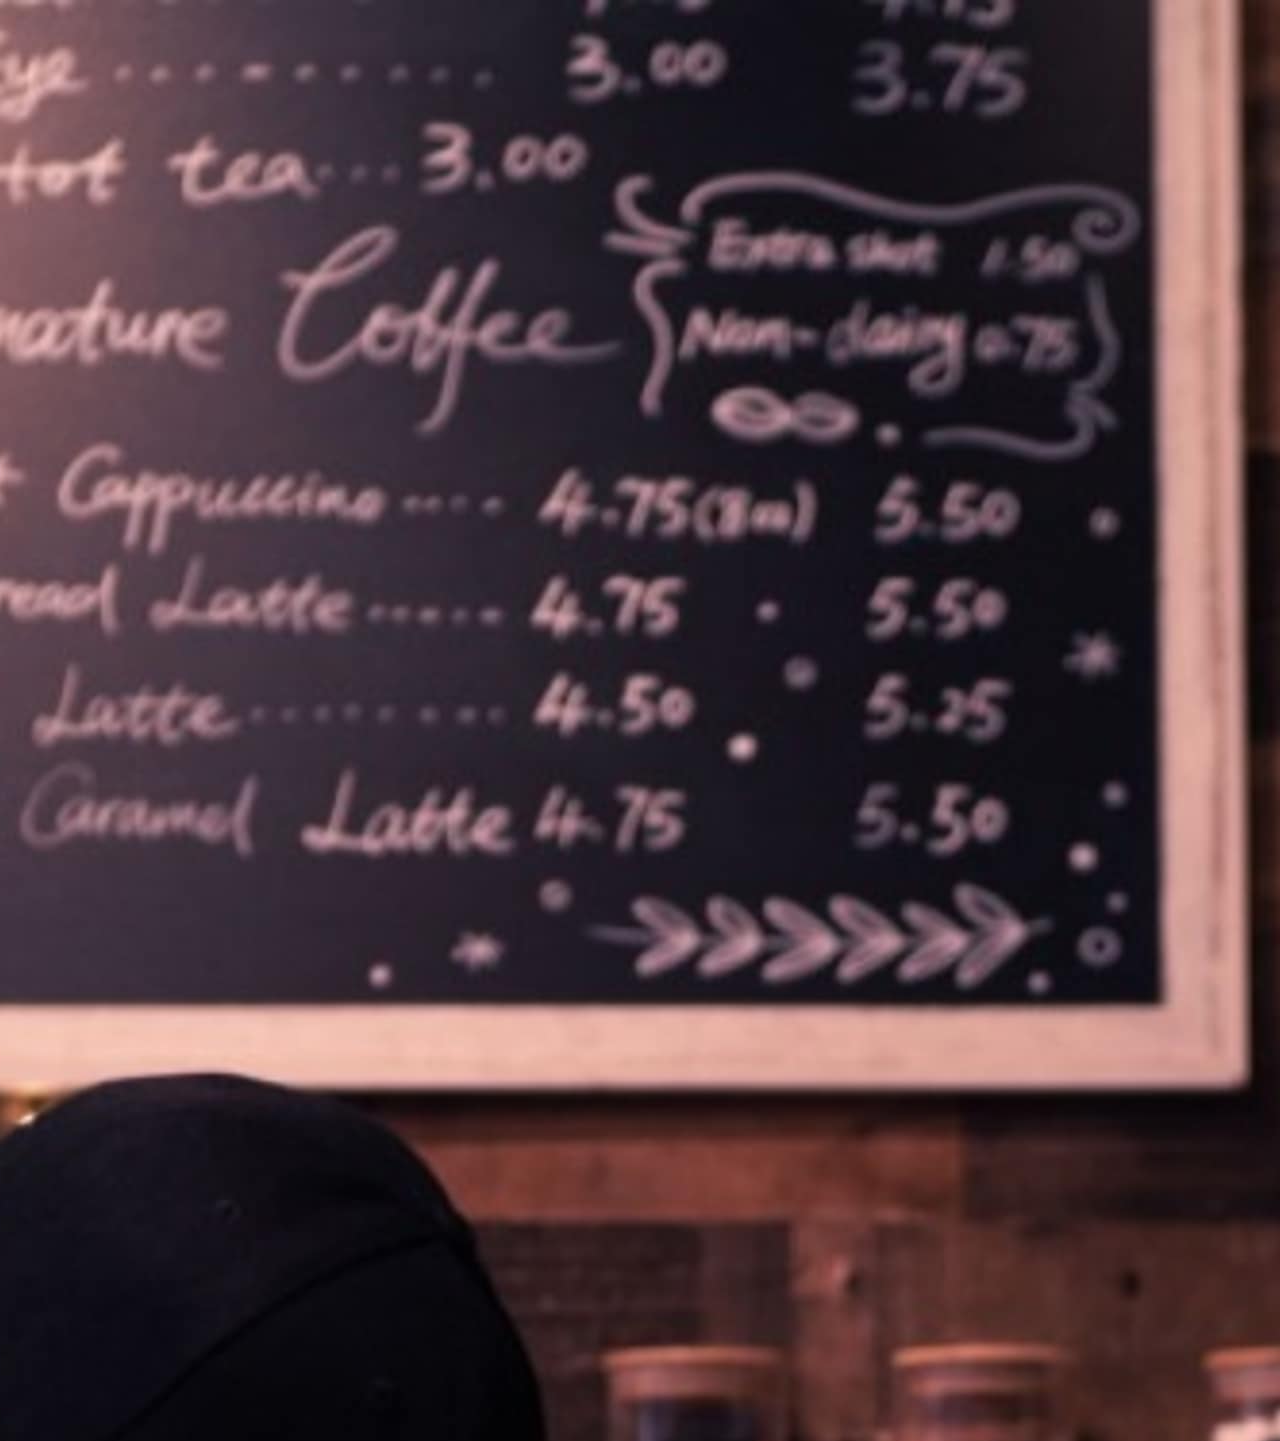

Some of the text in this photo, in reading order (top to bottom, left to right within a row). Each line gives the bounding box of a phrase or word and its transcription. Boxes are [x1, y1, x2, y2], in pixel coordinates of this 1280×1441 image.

[565, 33, 728, 103] 3.00
[851, 39, 1028, 117] 3.75
[168, 145, 318, 205] tea
[421, 121, 589, 193] 3.00
[708, 217, 836, 271] Extra
[276, 224, 622, 435] Coffee
[874, 474, 1022, 543] 5.50
[148, 558, 354, 633] Latte
[531, 575, 685, 638] 4.75
[866, 575, 1008, 639] 5.50
[31, 664, 239, 747] Latte
[532, 672, 696, 735] 4.50
[864, 672, 1012, 741] 5.25
[19, 764, 258, 855] Caramel
[300, 770, 517, 857] Latte
[532, 785, 686, 852] 4.75
[856, 782, 1010, 856] 5.50
